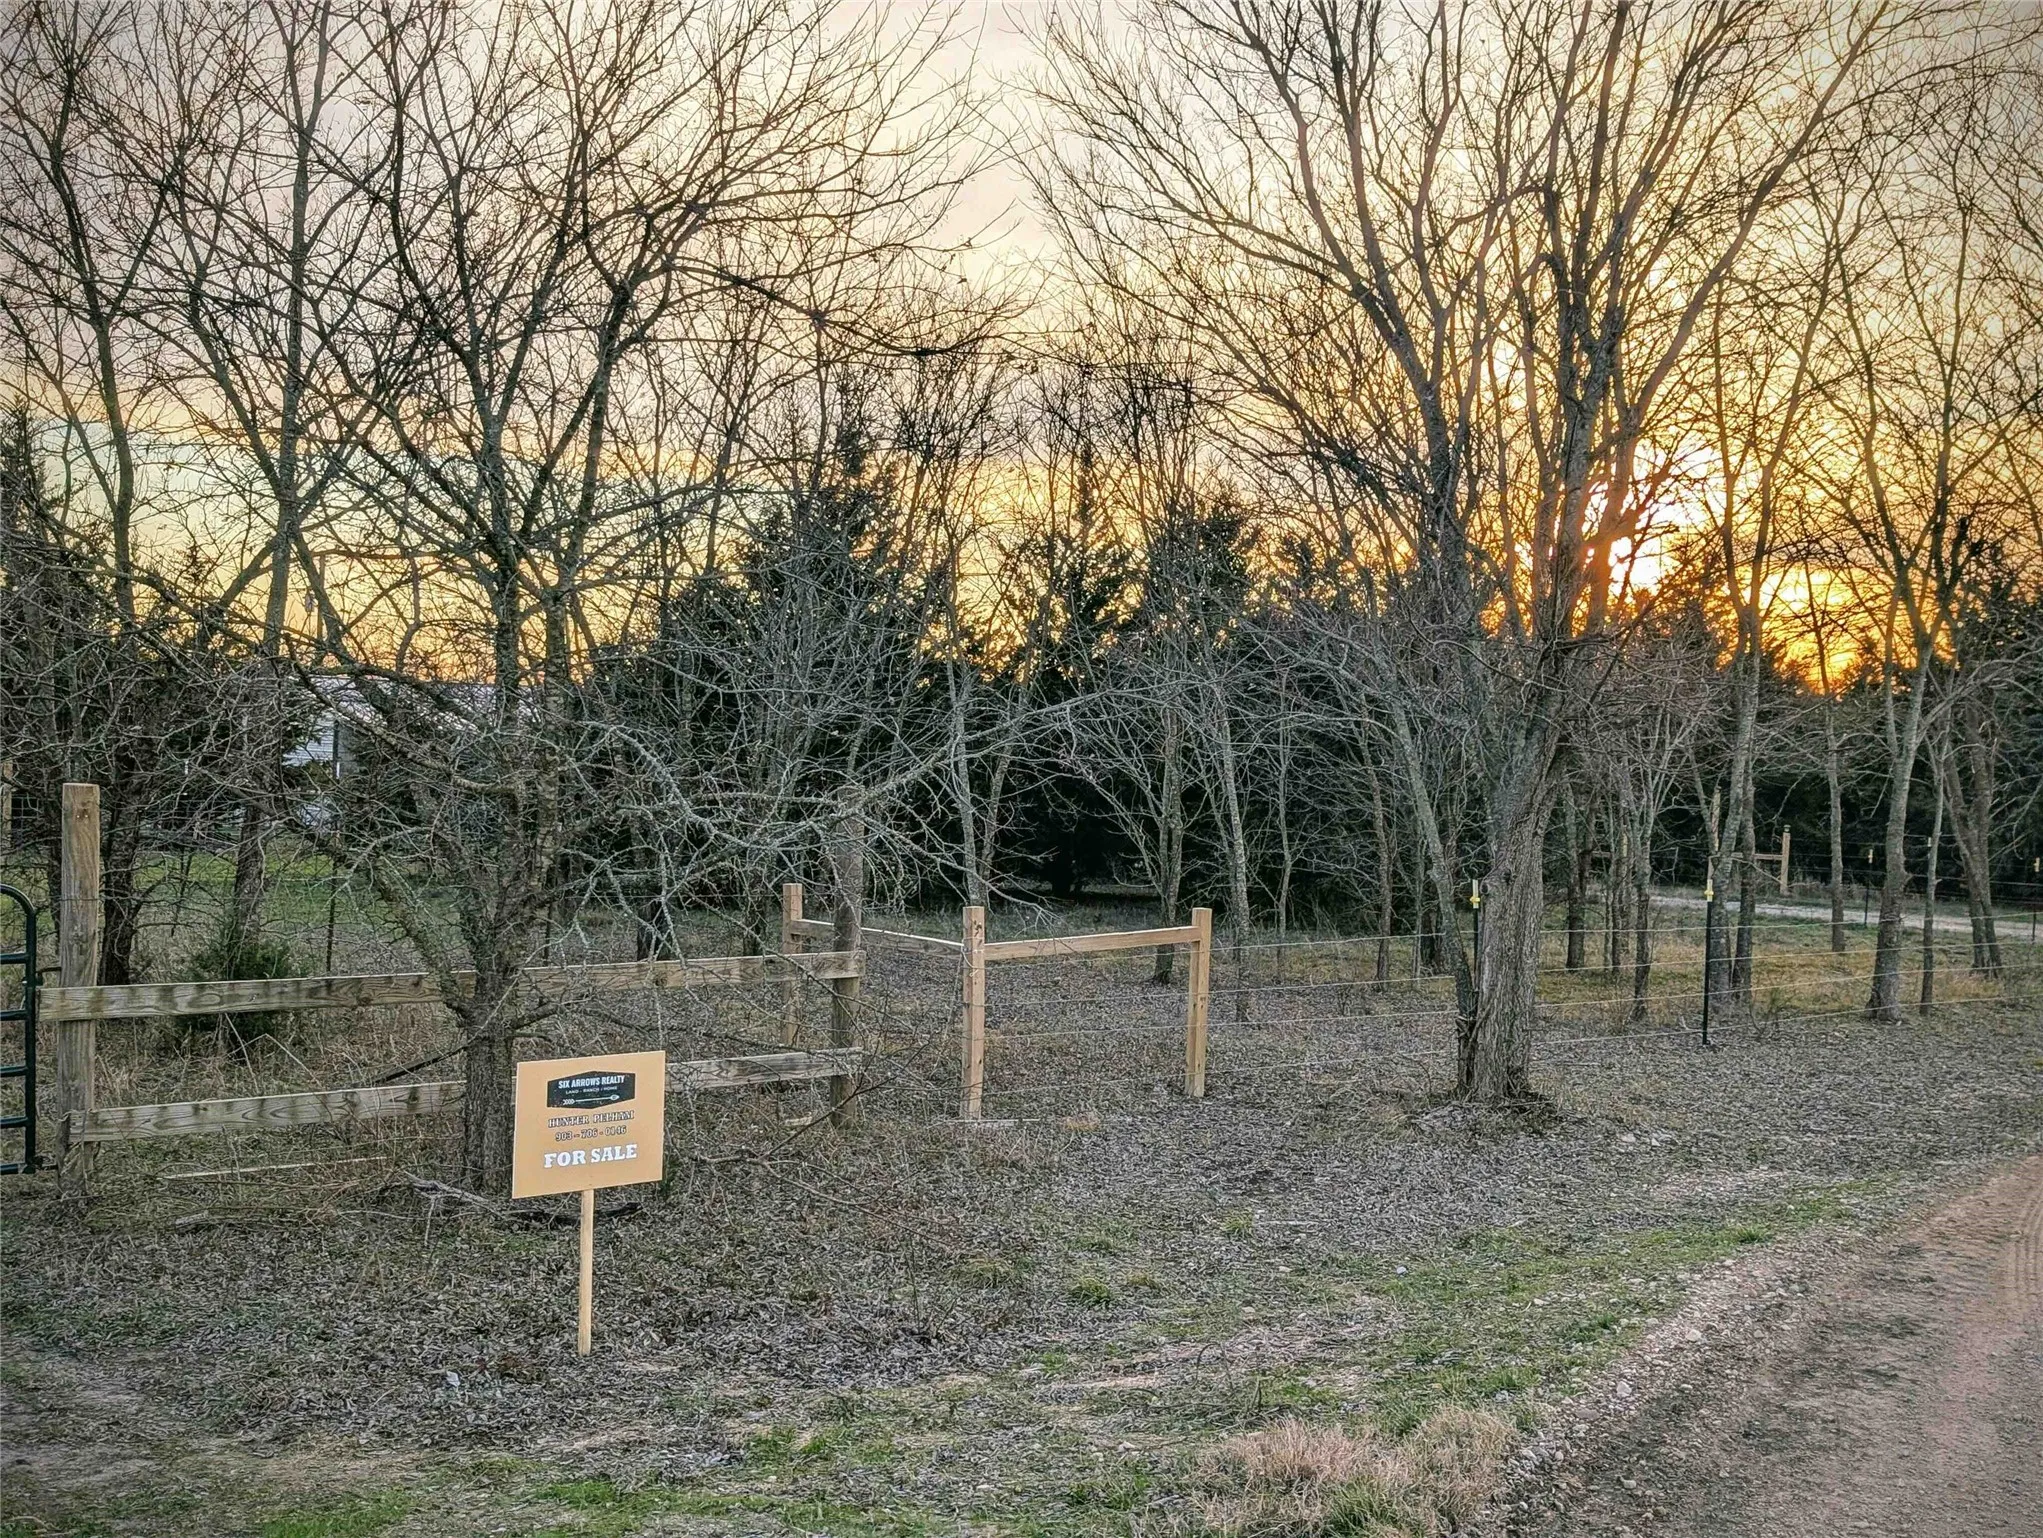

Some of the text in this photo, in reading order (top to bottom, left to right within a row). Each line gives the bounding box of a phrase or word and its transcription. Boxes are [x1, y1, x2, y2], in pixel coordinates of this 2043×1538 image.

[558, 1075, 625, 1089] SIX ARROWS REALTY
[548, 1110, 635, 1128] HUNTER PELHAM
[544, 1144, 638, 1168] FOR SALE
